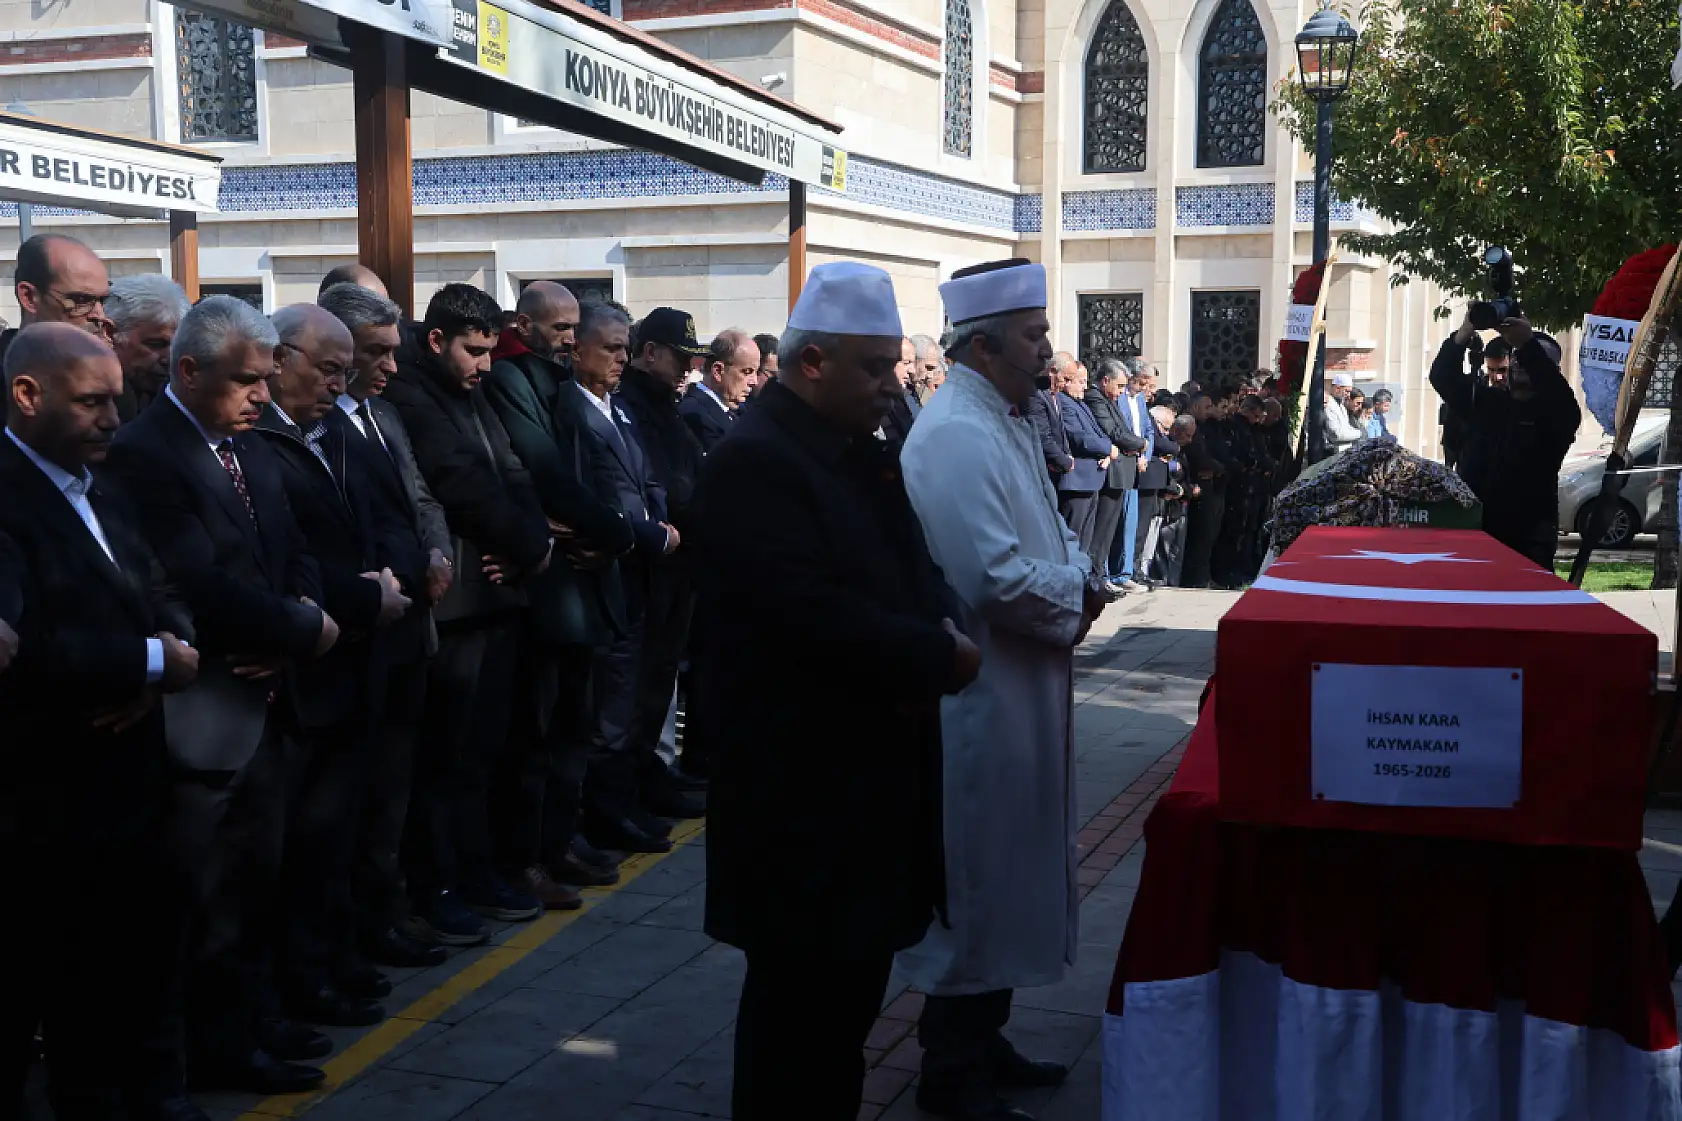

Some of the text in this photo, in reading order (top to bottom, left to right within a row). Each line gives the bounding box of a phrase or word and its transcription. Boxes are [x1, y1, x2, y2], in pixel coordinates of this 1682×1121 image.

[565, 49, 796, 169] KONYA BÜYÜKŞEHİR BELEDİYESİ
[32, 154, 196, 199] BELEDİYESİ
[1366, 708, 1461, 728] İHSAN KARA
[1366, 736, 1460, 754] KAYMAKAM
[1373, 762, 1452, 779] 1965-2026
